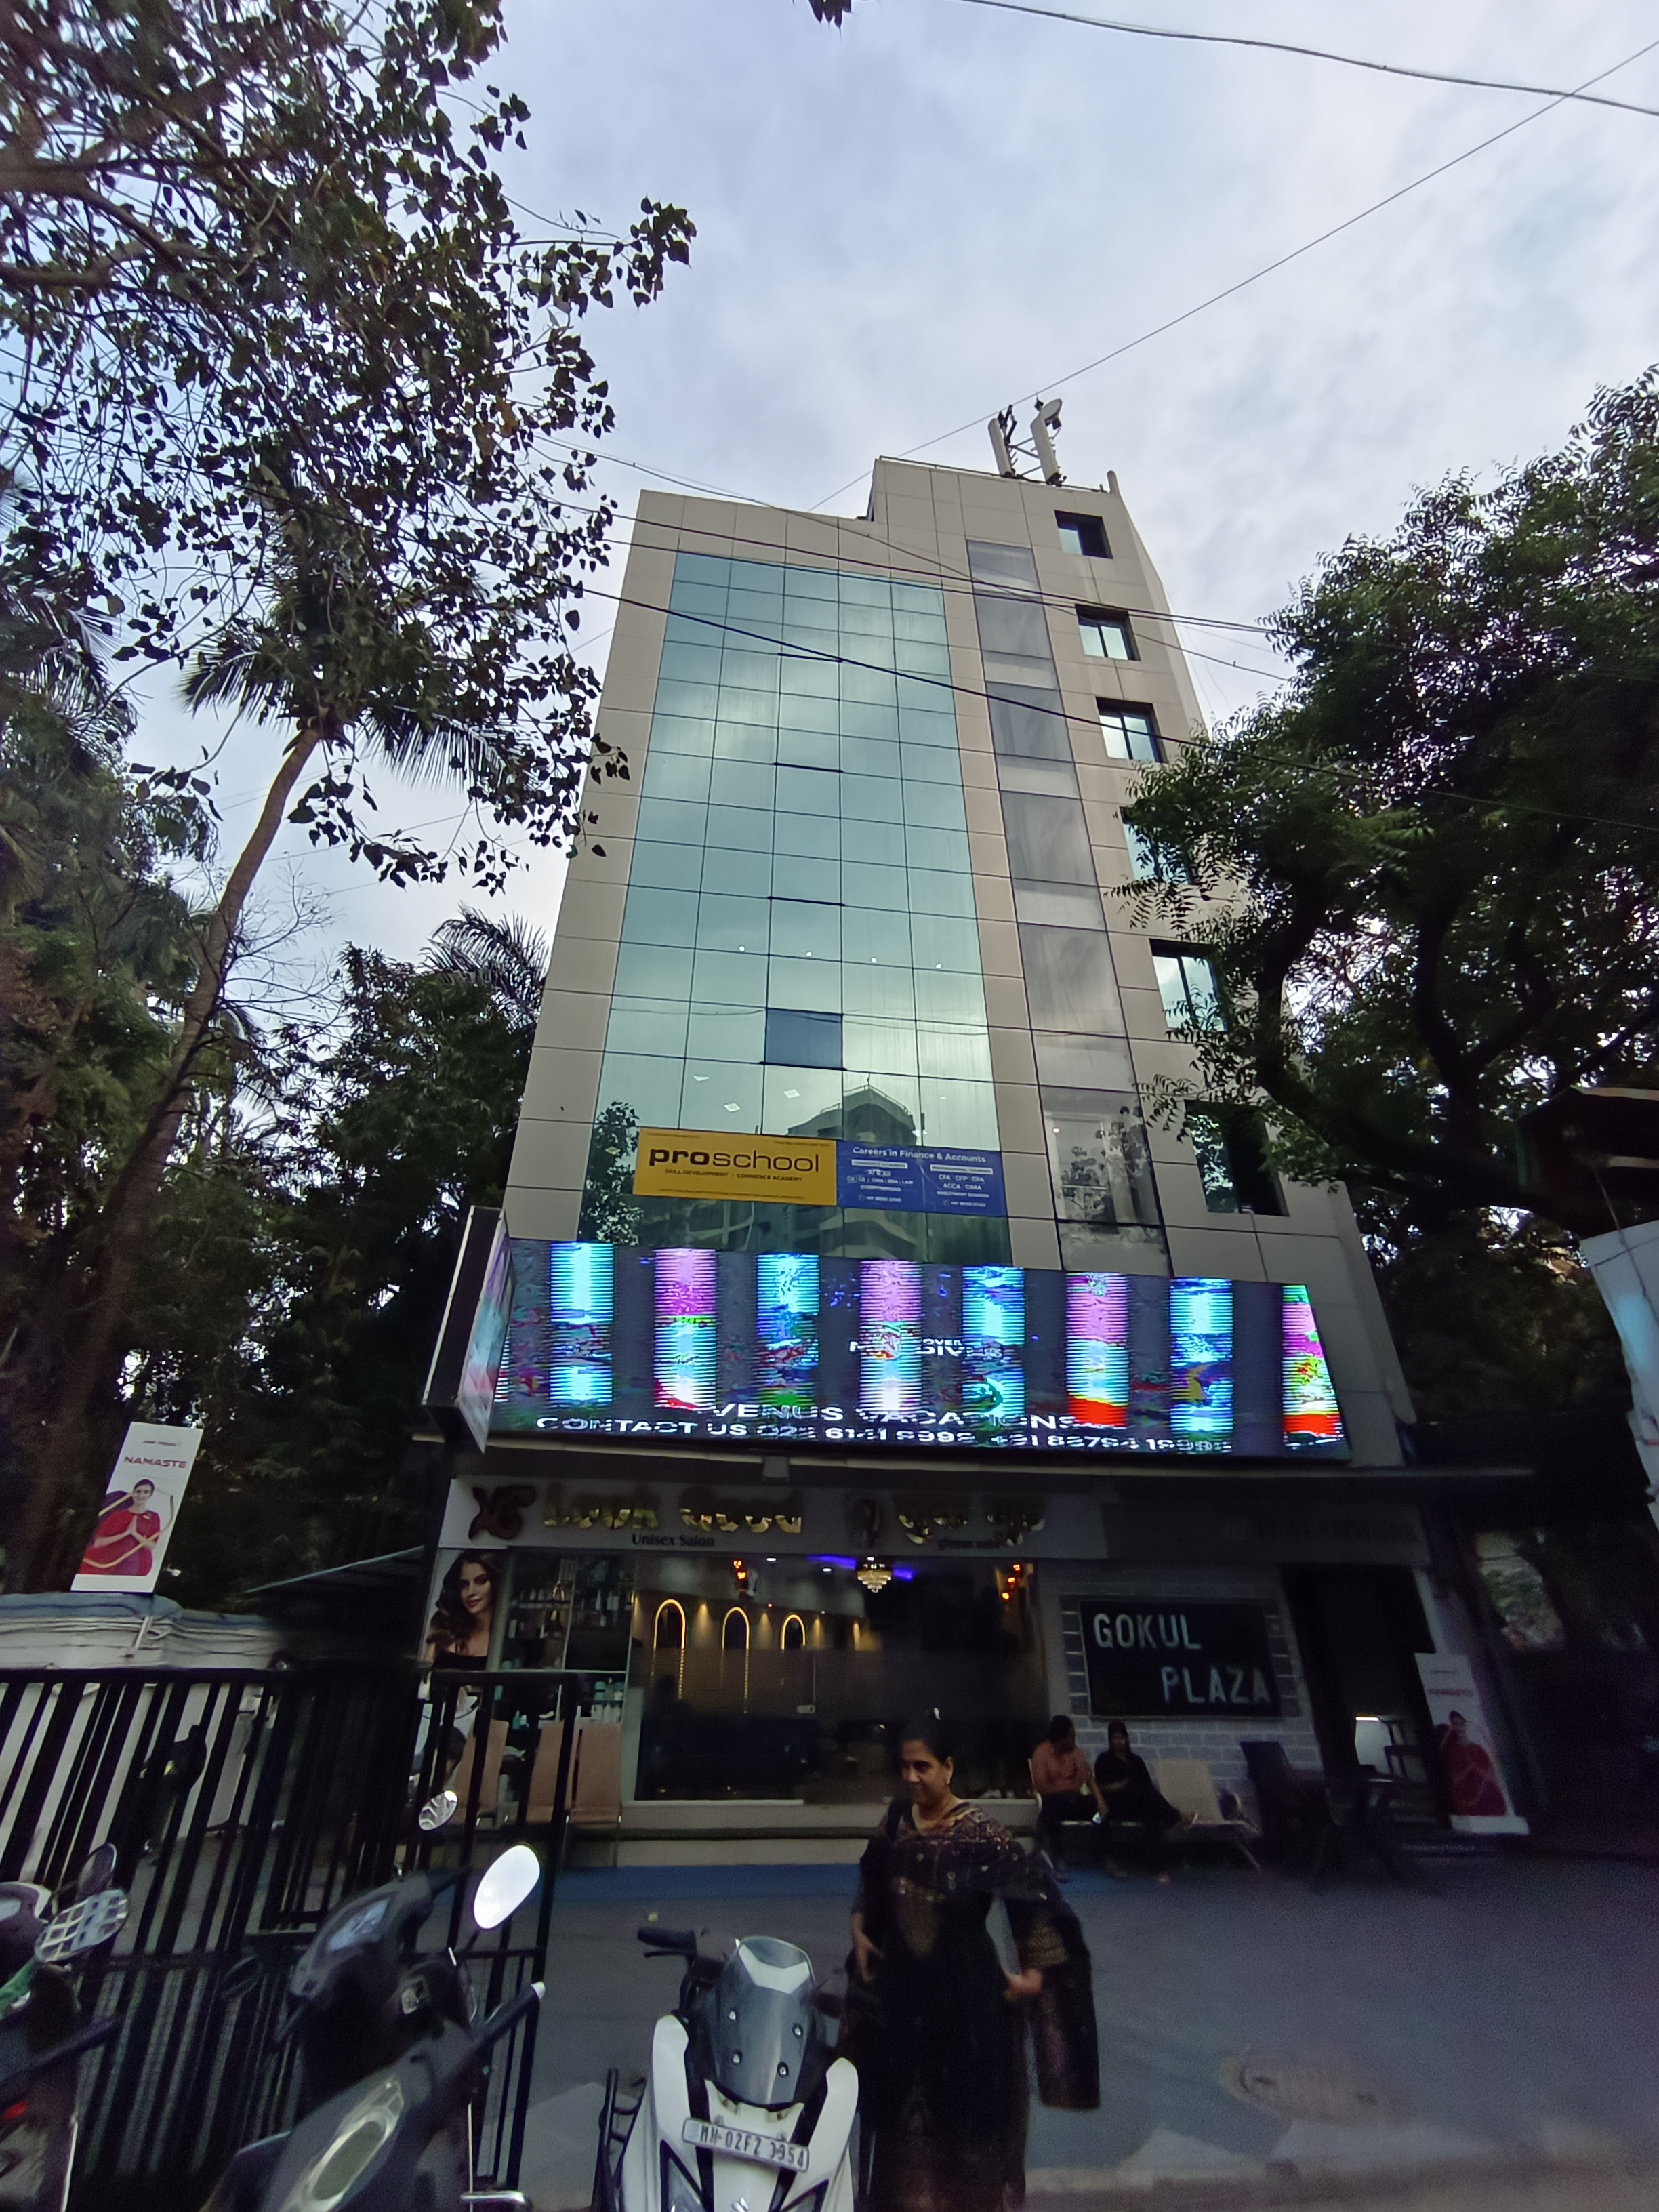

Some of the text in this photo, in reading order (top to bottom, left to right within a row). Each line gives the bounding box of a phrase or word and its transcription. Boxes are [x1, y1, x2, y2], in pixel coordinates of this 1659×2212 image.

[649, 1148, 819, 1173] proschool
[852, 1146, 887, 1157] Careers
[888, 1147, 898, 1157] in
[899, 1149, 935, 1160] Finance
[945, 1153, 987, 1163] Accounts
[537, 1416, 699, 1434] CONTACT
[707, 1422, 747, 1436] US
[124, 1456, 187, 1469] NAMASTE
[632, 1533, 715, 1547] Unisex Salon
[1092, 1612, 1202, 1650] GOKUL
[1160, 1665, 1272, 1704] PLAZA
